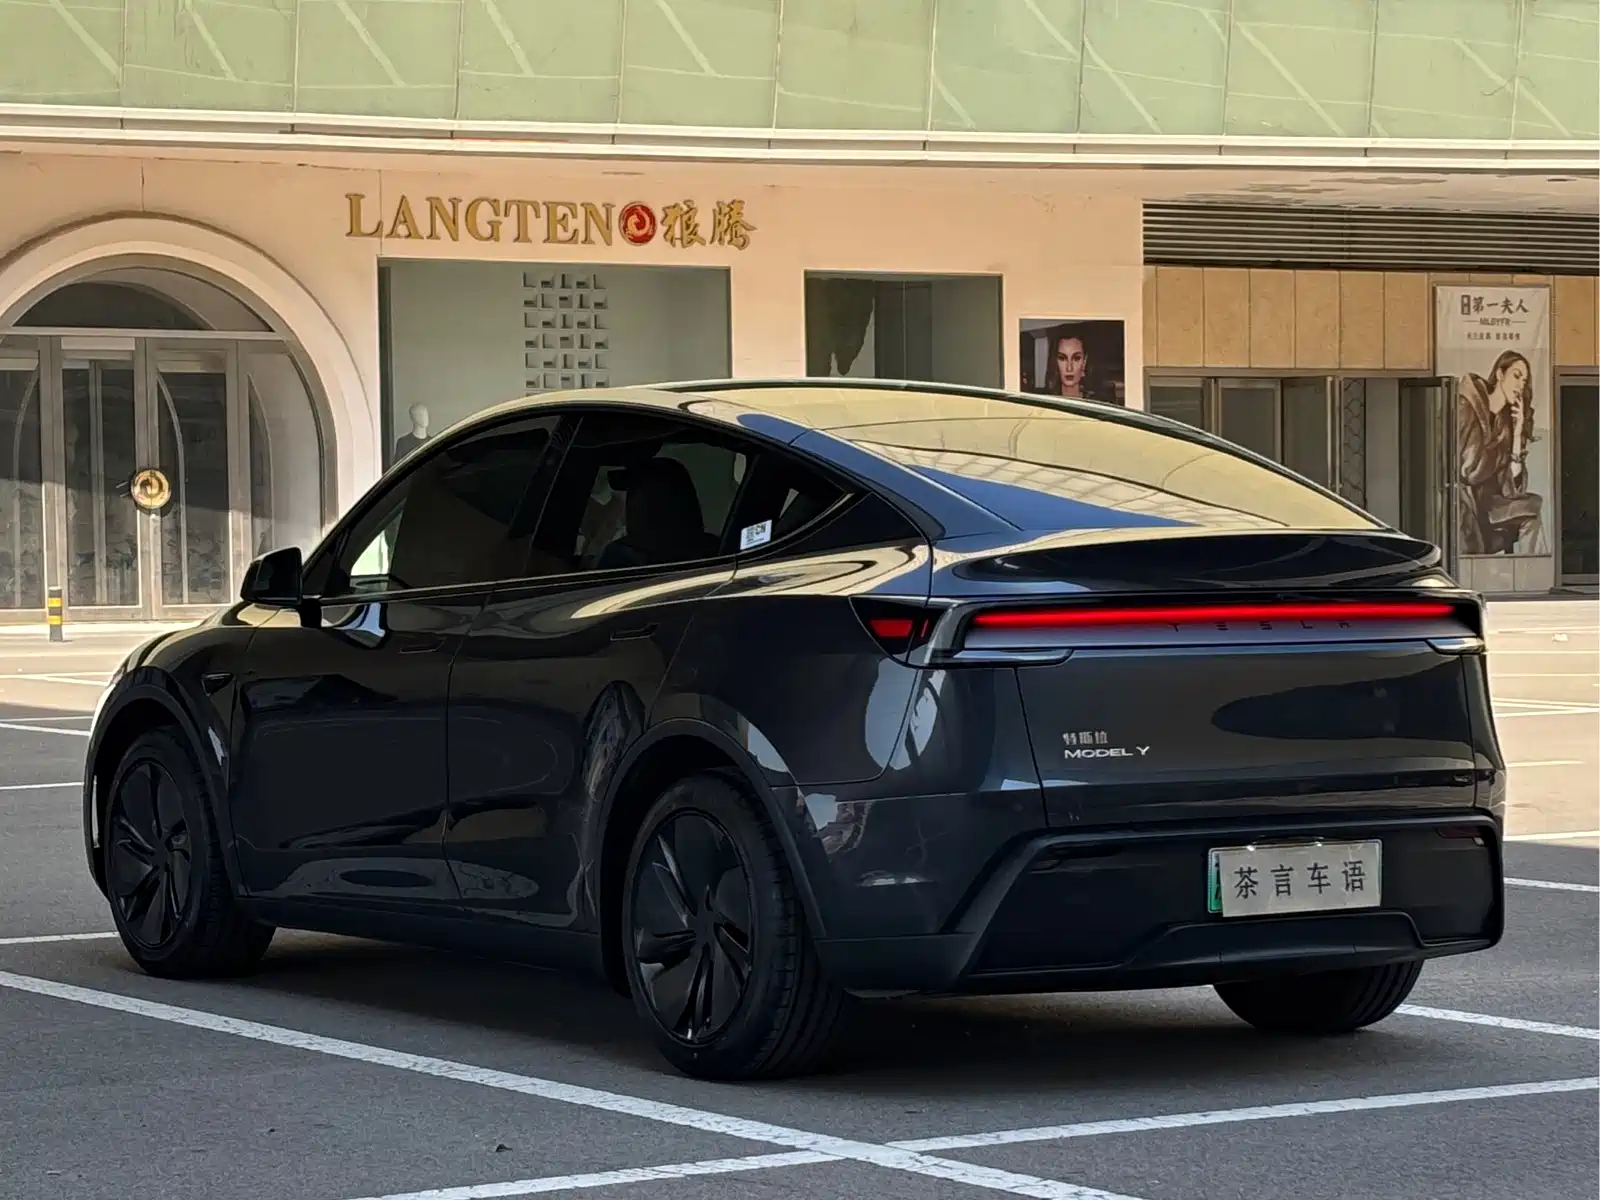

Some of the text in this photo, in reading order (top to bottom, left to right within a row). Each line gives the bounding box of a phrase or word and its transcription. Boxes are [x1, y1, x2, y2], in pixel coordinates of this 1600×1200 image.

[345, 193, 615, 246] LANGTEN
[1472, 296, 1529, 314] 第一夫人
[1062, 731, 1108, 745] 特斯拉
[1064, 746, 1150, 759] MODEL Y
[1234, 860, 1366, 900] 茶言车语
